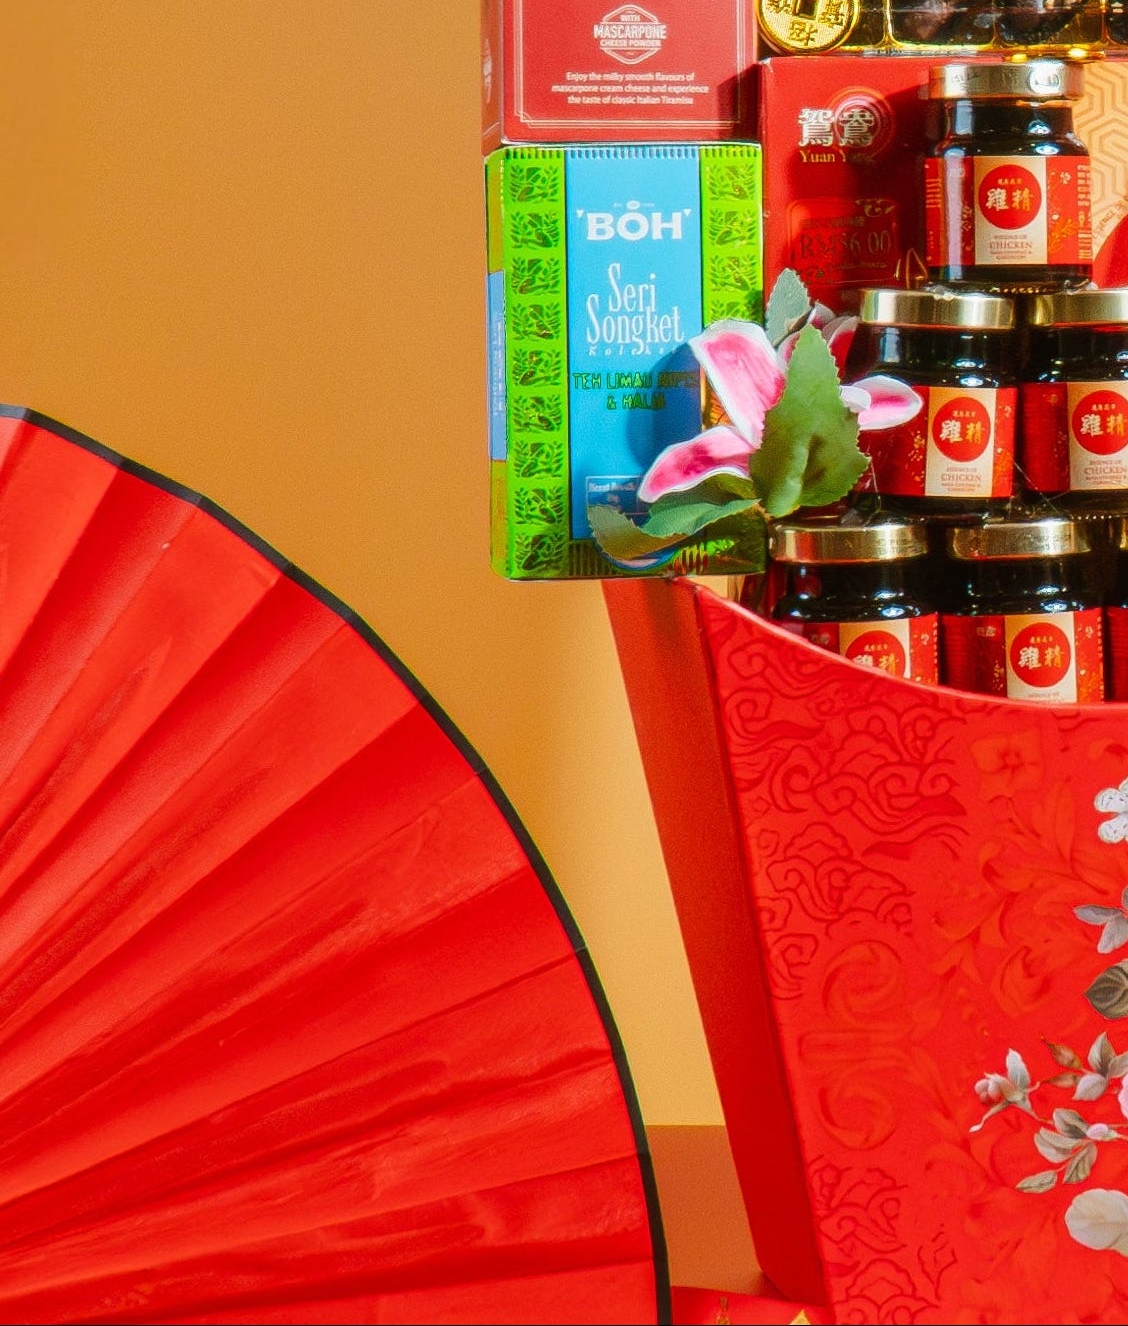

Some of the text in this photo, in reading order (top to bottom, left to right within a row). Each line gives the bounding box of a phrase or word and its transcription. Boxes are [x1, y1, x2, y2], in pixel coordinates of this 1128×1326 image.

[594, 25, 667, 40] MASCARPONE
[798, 108, 875, 147] 鴛鴦
[800, 150, 836, 163] Yuan
[609, 262, 656, 312] Seri
[586, 293, 685, 355] Songket
